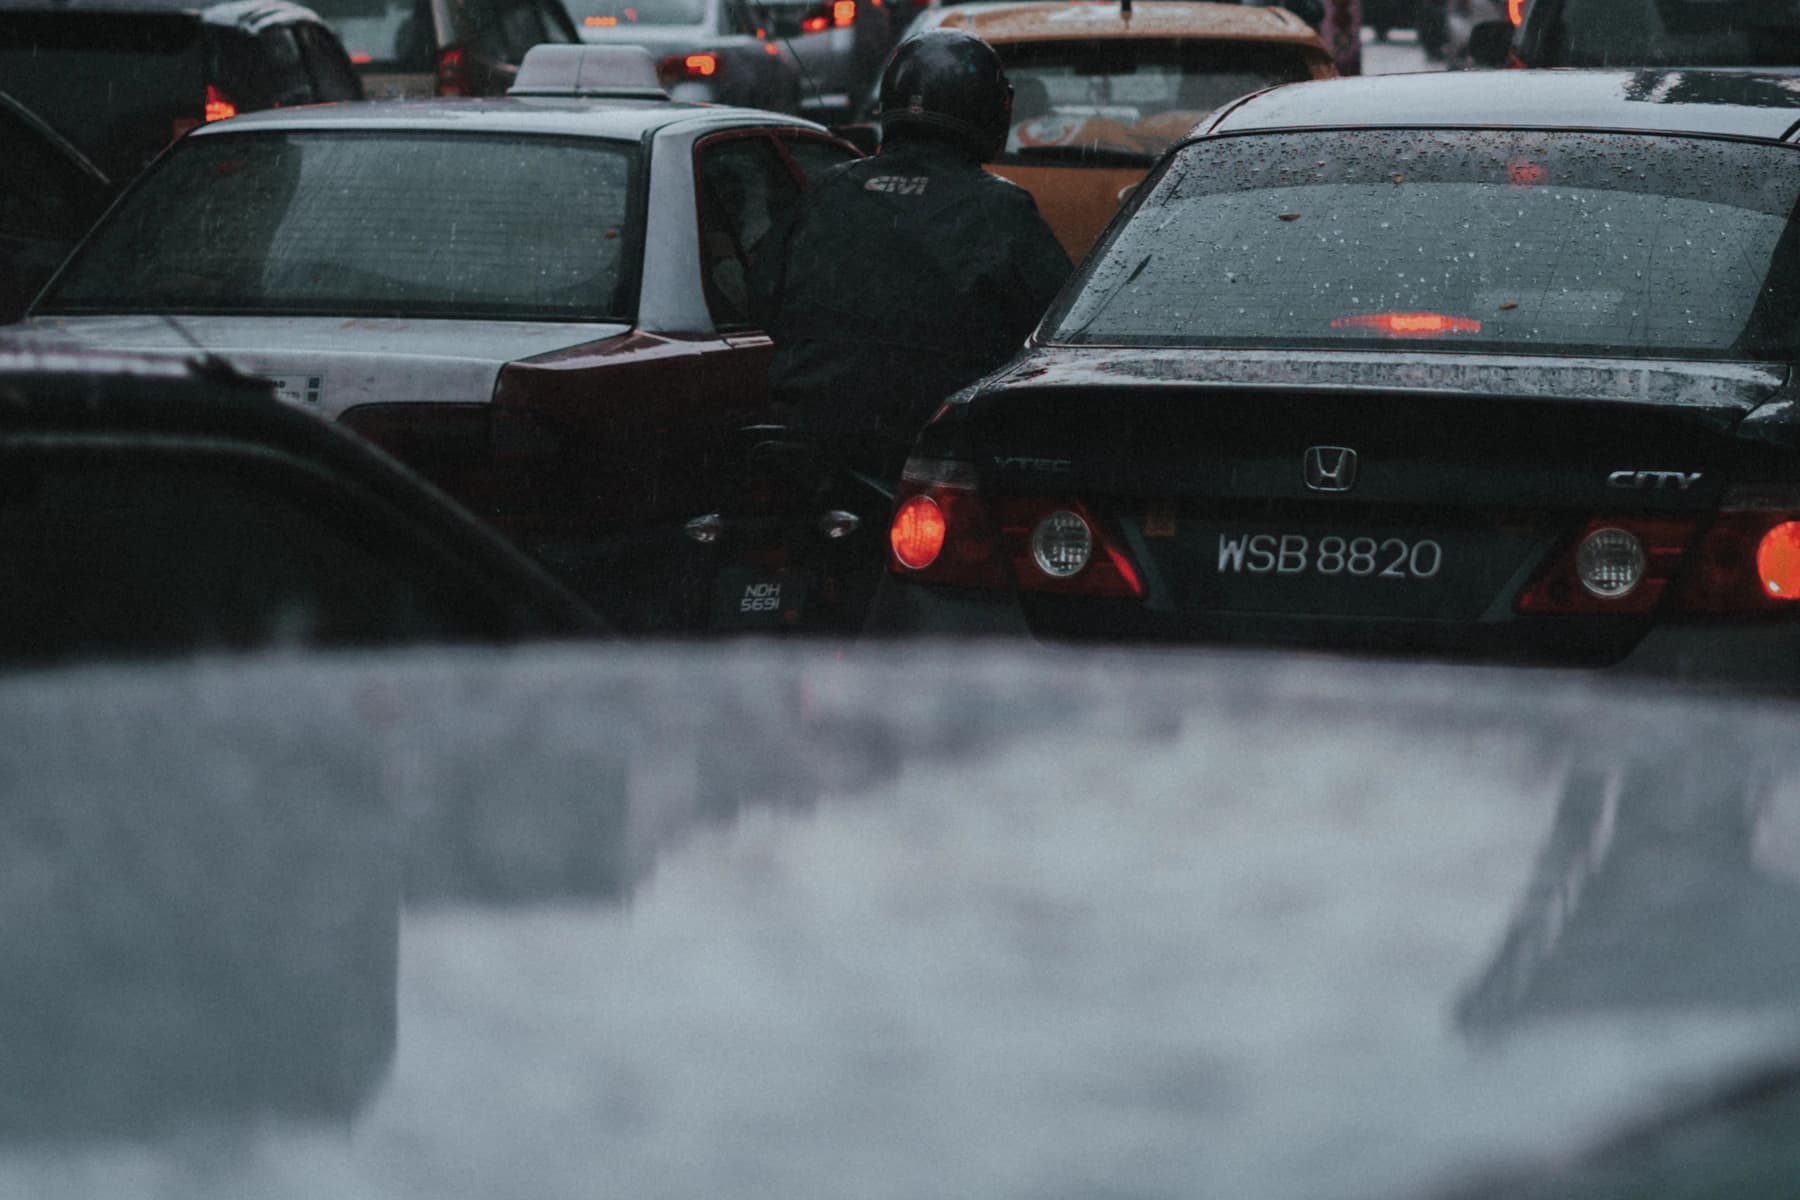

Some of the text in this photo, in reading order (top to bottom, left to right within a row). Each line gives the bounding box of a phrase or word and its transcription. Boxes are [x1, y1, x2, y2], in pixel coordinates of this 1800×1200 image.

[1606, 470, 1704, 490] CITY
[1216, 533, 1443, 578] WSB 8820
